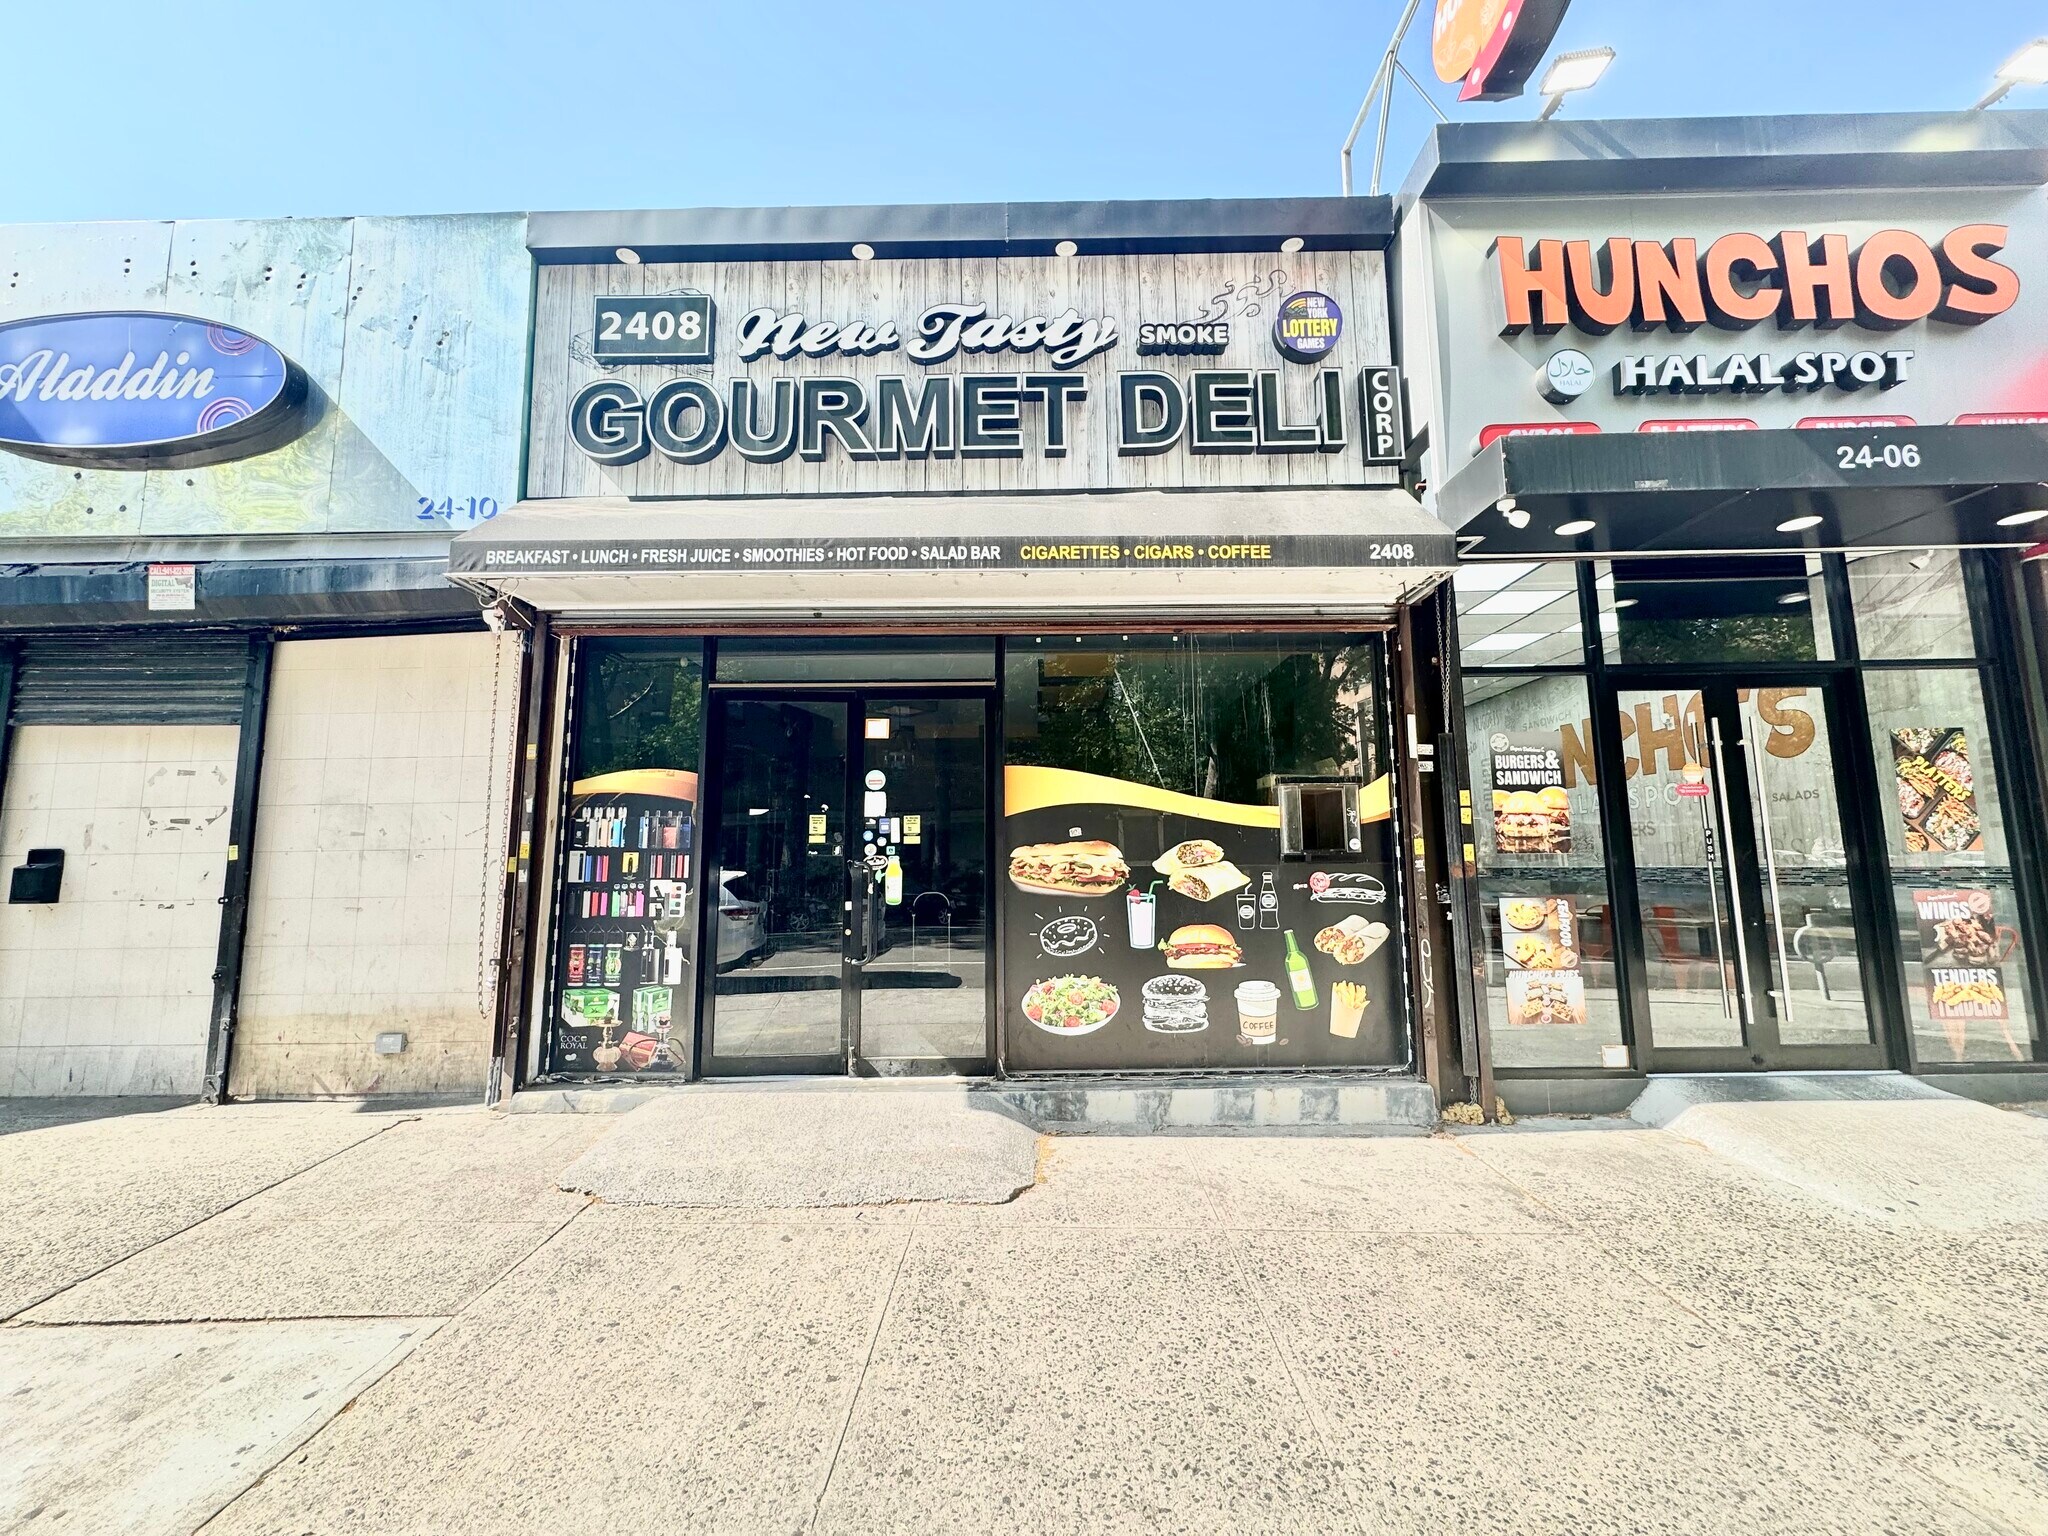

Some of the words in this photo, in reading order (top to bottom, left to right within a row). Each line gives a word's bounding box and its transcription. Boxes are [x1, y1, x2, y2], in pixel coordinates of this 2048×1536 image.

[1492, 224, 2020, 328] HUNCHOS
[1306, 296, 1326, 308] NEW
[1307, 307, 1329, 318] YORK
[600, 311, 702, 341] 2408
[737, 306, 900, 360] New
[906, 302, 1119, 368] Tasty
[1139, 323, 1229, 346] SMOKE
[1282, 318, 1338, 338] LOTTERY
[1296, 337, 1326, 350] GAMES
[0, 349, 216, 402] Aladdin
[1620, 353, 1784, 388] HALAL
[1794, 350, 1915, 384] SPOT
[1559, 379, 1583, 387] HALAL
[568, 371, 1089, 461] GOURMET
[1117, 366, 1348, 452] DELI
[1370, 370, 1395, 456] CORP
[1836, 443, 1922, 469] 24-06
[416, 495, 498, 520] 24-10
[485, 549, 570, 565] BREAKFAST
[581, 549, 629, 565] LUNCH
[640, 548, 687, 564] FRESH
[689, 548, 731, 563] JUICE
[742, 547, 825, 563] SMOOTHIES
[836, 546, 866, 562] HOT
[868, 545, 909, 561] FOOD
[920, 545, 968, 561] SALAD
[970, 545, 1001, 561] BAR
[1020, 544, 1120, 561] CIGARETTES
[1133, 544, 1194, 560] CIGARS
[1208, 543, 1272, 560] COFFEE
[1369, 542, 1415, 560] 2408
[151, 579, 176, 588] DIGITAL
[1494, 754, 1545, 770] BURGERS
[1495, 769, 1563, 786] SANDWICH
[1911, 754, 1973, 802] PLATTERS
[1772, 789, 1820, 803] SALADS
[1704, 829, 1715, 860] PUSH
[1916, 901, 1971, 920] WINGS
[1931, 968, 1998, 986] TENDERS
[1242, 1020, 1275, 1031] COFFEE
[560, 1041, 588, 1050] ROYAL
